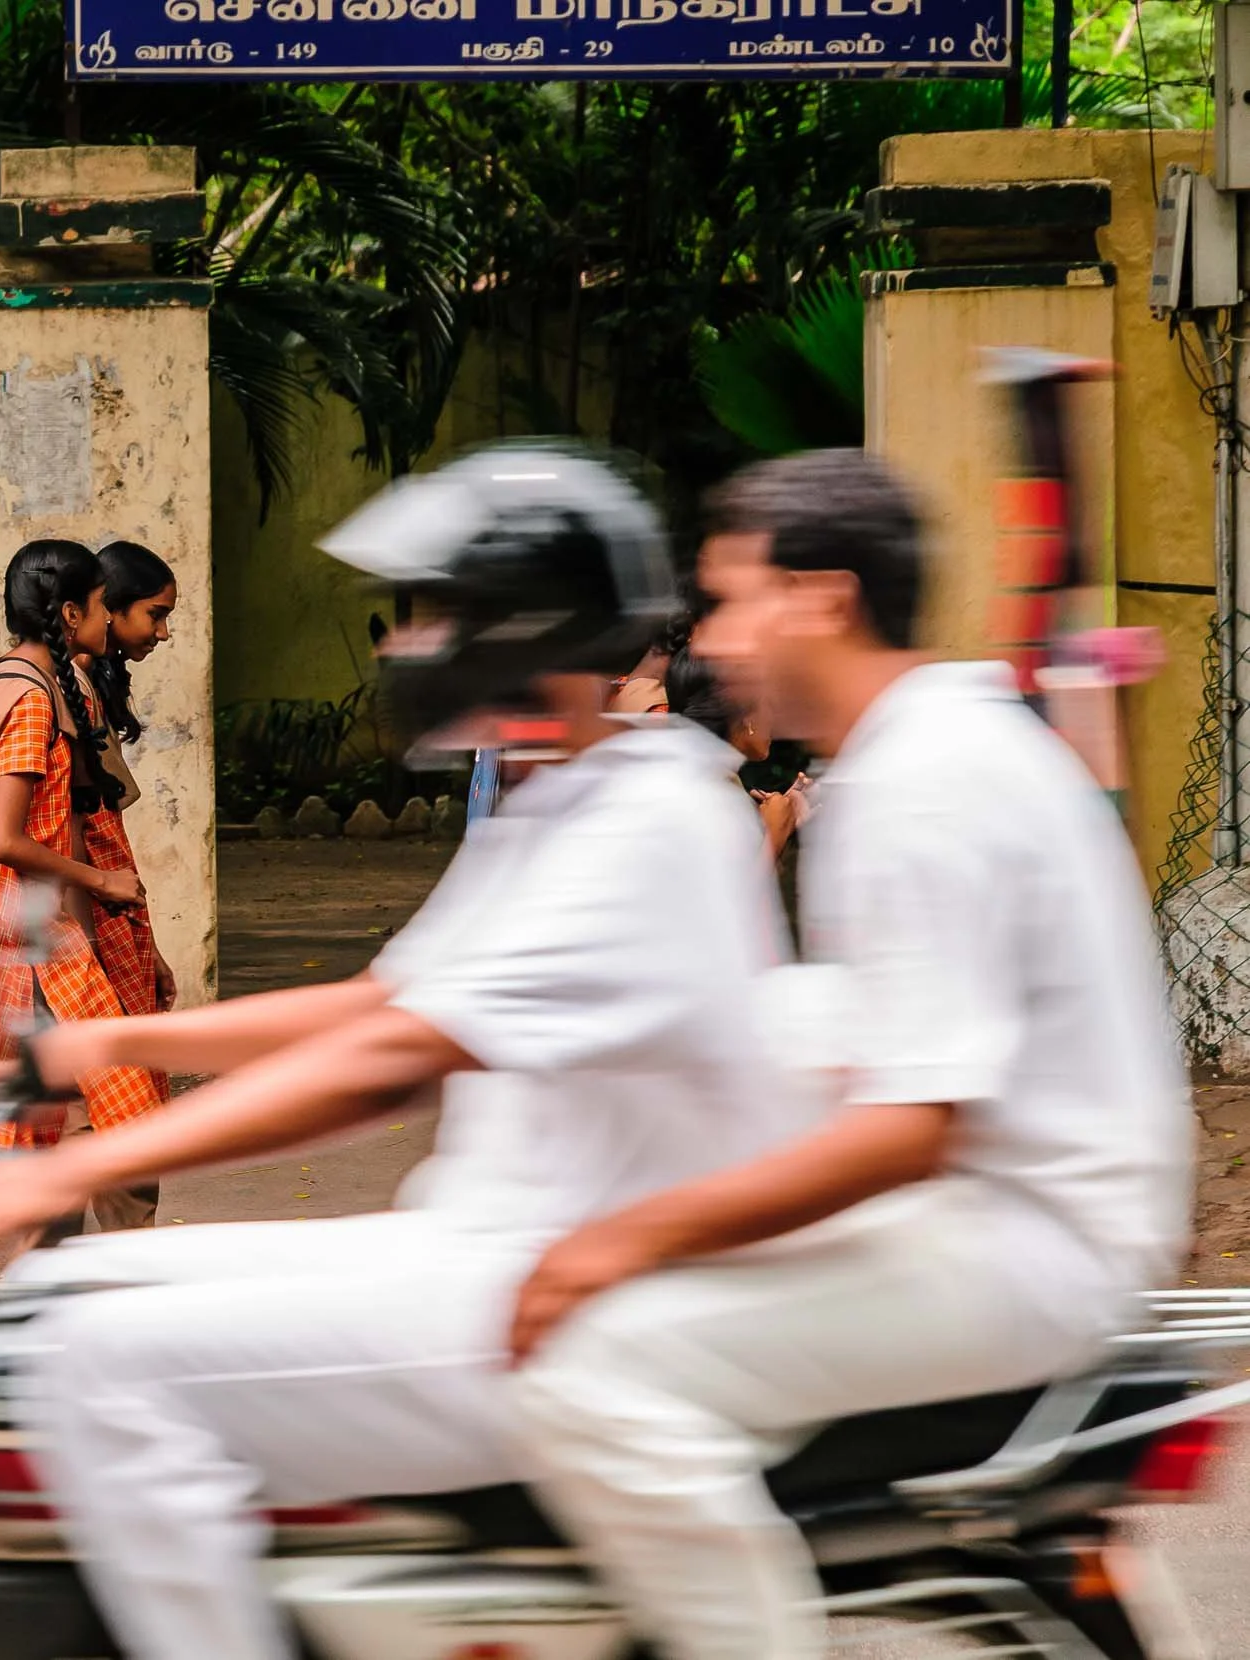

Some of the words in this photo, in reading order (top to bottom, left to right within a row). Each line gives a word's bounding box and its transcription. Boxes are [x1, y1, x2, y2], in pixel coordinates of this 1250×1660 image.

[134, 38, 235, 62] வார்டு
[276, 42, 318, 60] 149
[461, 36, 544, 62] பகுதி
[584, 40, 614, 57] 29
[729, 32, 886, 56] மண்டலம்
[927, 37, 956, 54] 10
